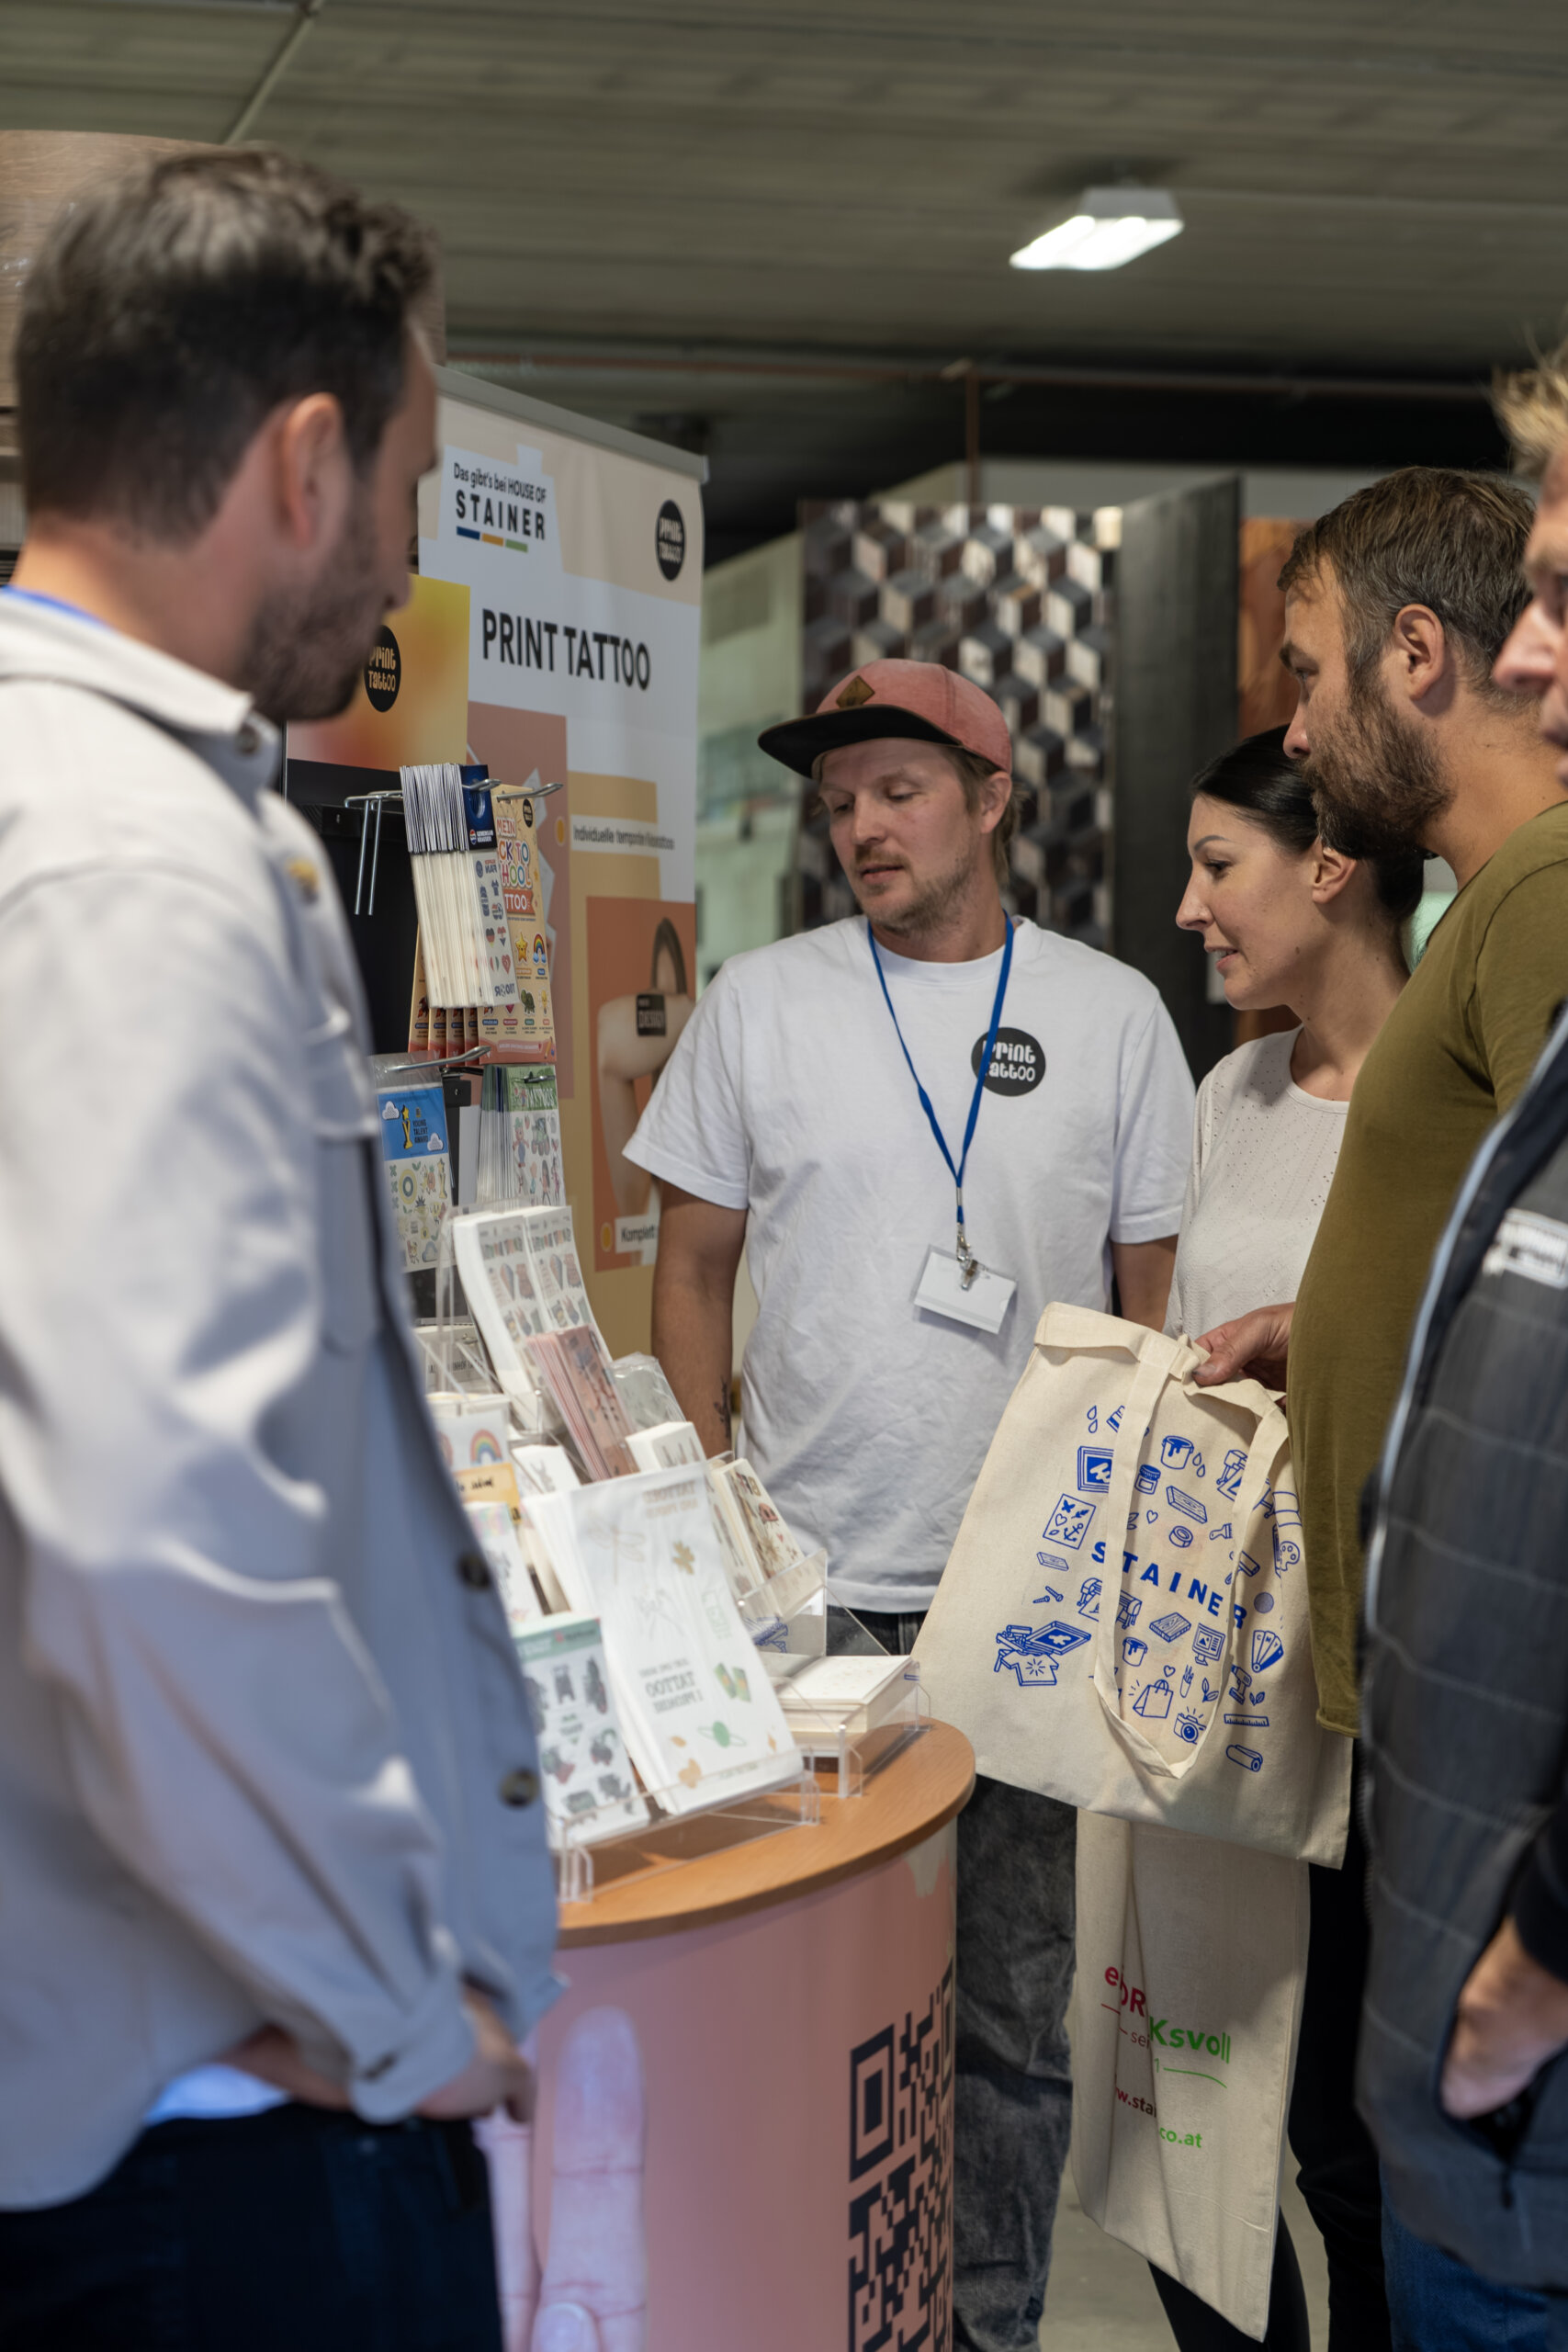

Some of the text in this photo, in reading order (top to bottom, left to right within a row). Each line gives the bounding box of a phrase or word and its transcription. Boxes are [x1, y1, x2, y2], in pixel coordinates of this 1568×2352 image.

[454, 462, 468, 481] Das
[494, 473, 506, 492] bei
[508, 477, 534, 500] HOUSE
[536, 487, 546, 503] OF
[456, 489, 545, 540] STAINER
[482, 608, 650, 691] PRINT TATTOO
[497, 820, 514, 835] MEIN
[500, 841, 529, 862] CK TO
